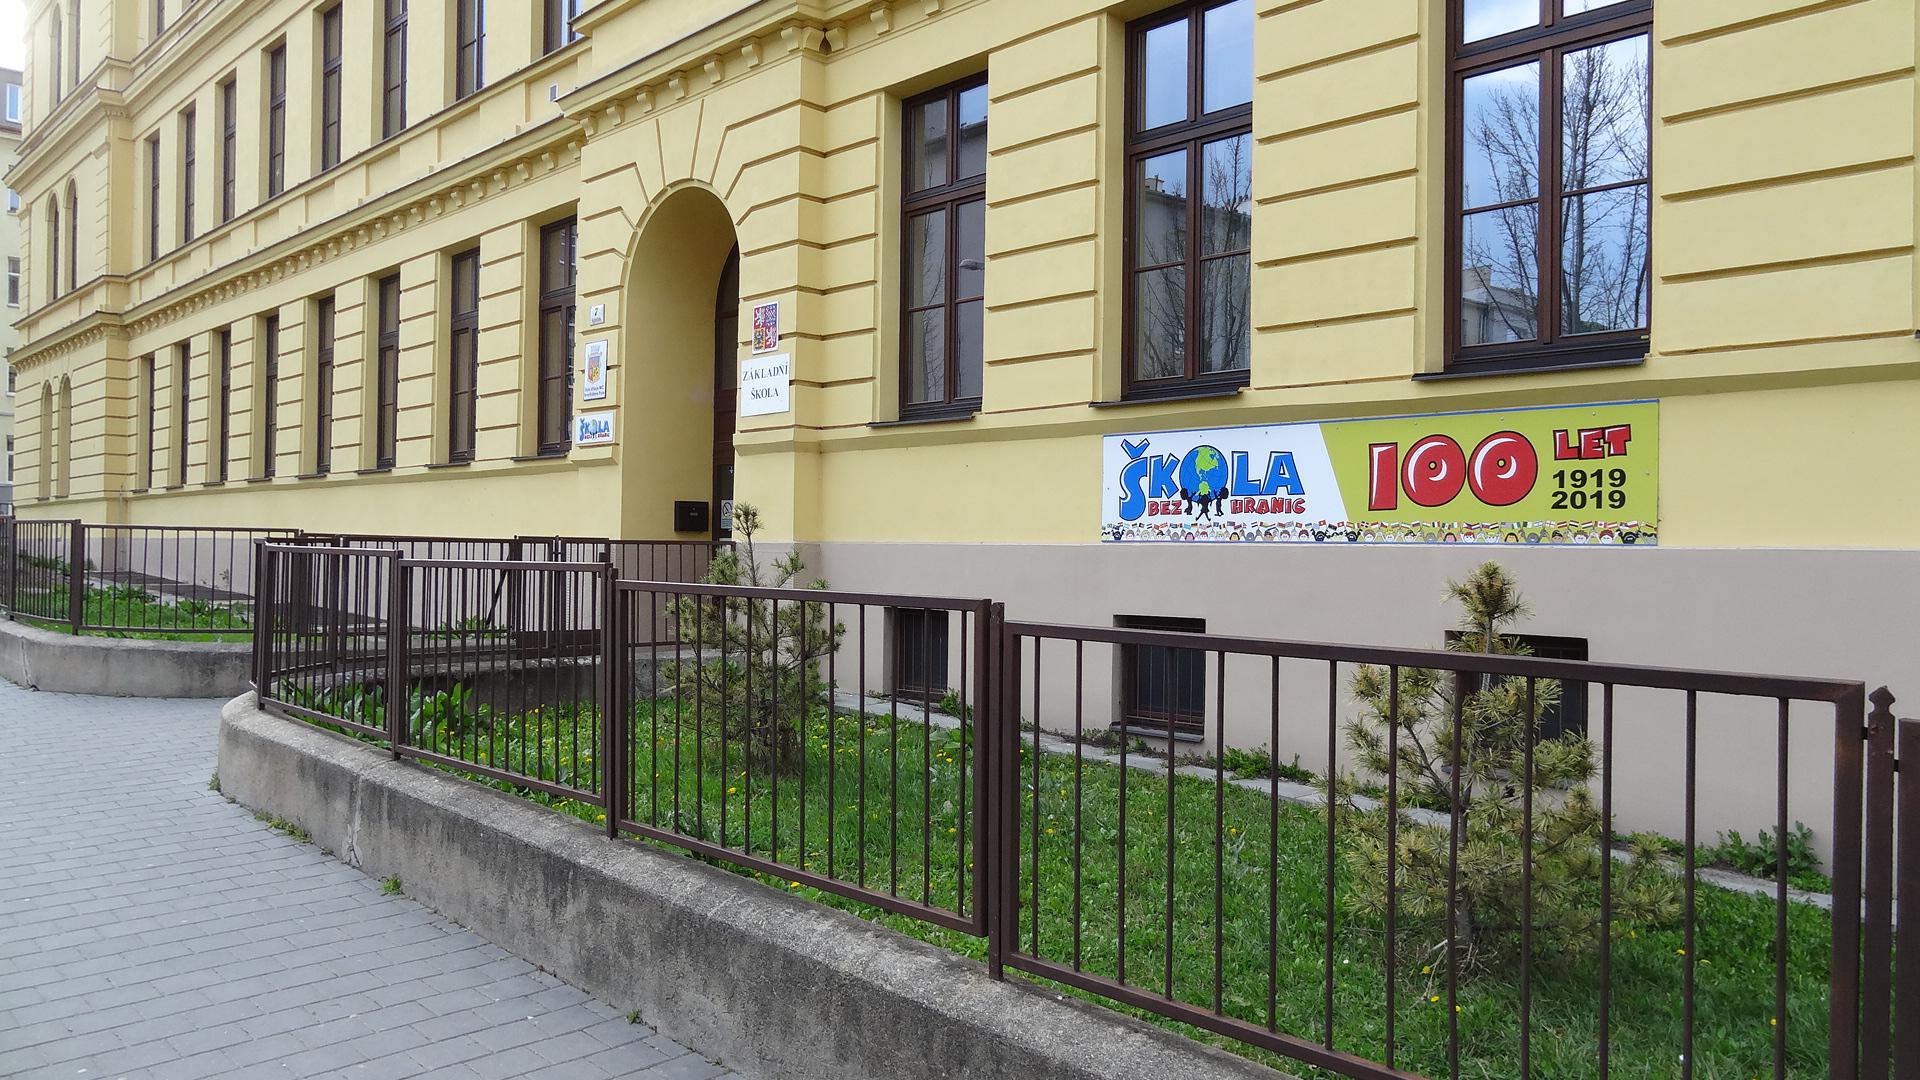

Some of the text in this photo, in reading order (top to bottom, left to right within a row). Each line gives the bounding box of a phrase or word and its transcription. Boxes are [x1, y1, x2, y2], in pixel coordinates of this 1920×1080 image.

[743, 362, 788, 381] ZÁKLADNÍ
[751, 388, 779, 400] ŠKOLA
[579, 418, 610, 441] ŠKOLA
[1553, 424, 1631, 460] LET
[1119, 438, 1306, 521] ŠKOLA
[1368, 431, 1539, 511] 100
[1552, 469, 1627, 489] 1919
[1148, 497, 1306, 516] BEZ HRANIC
[1551, 490, 1627, 509] 2019
